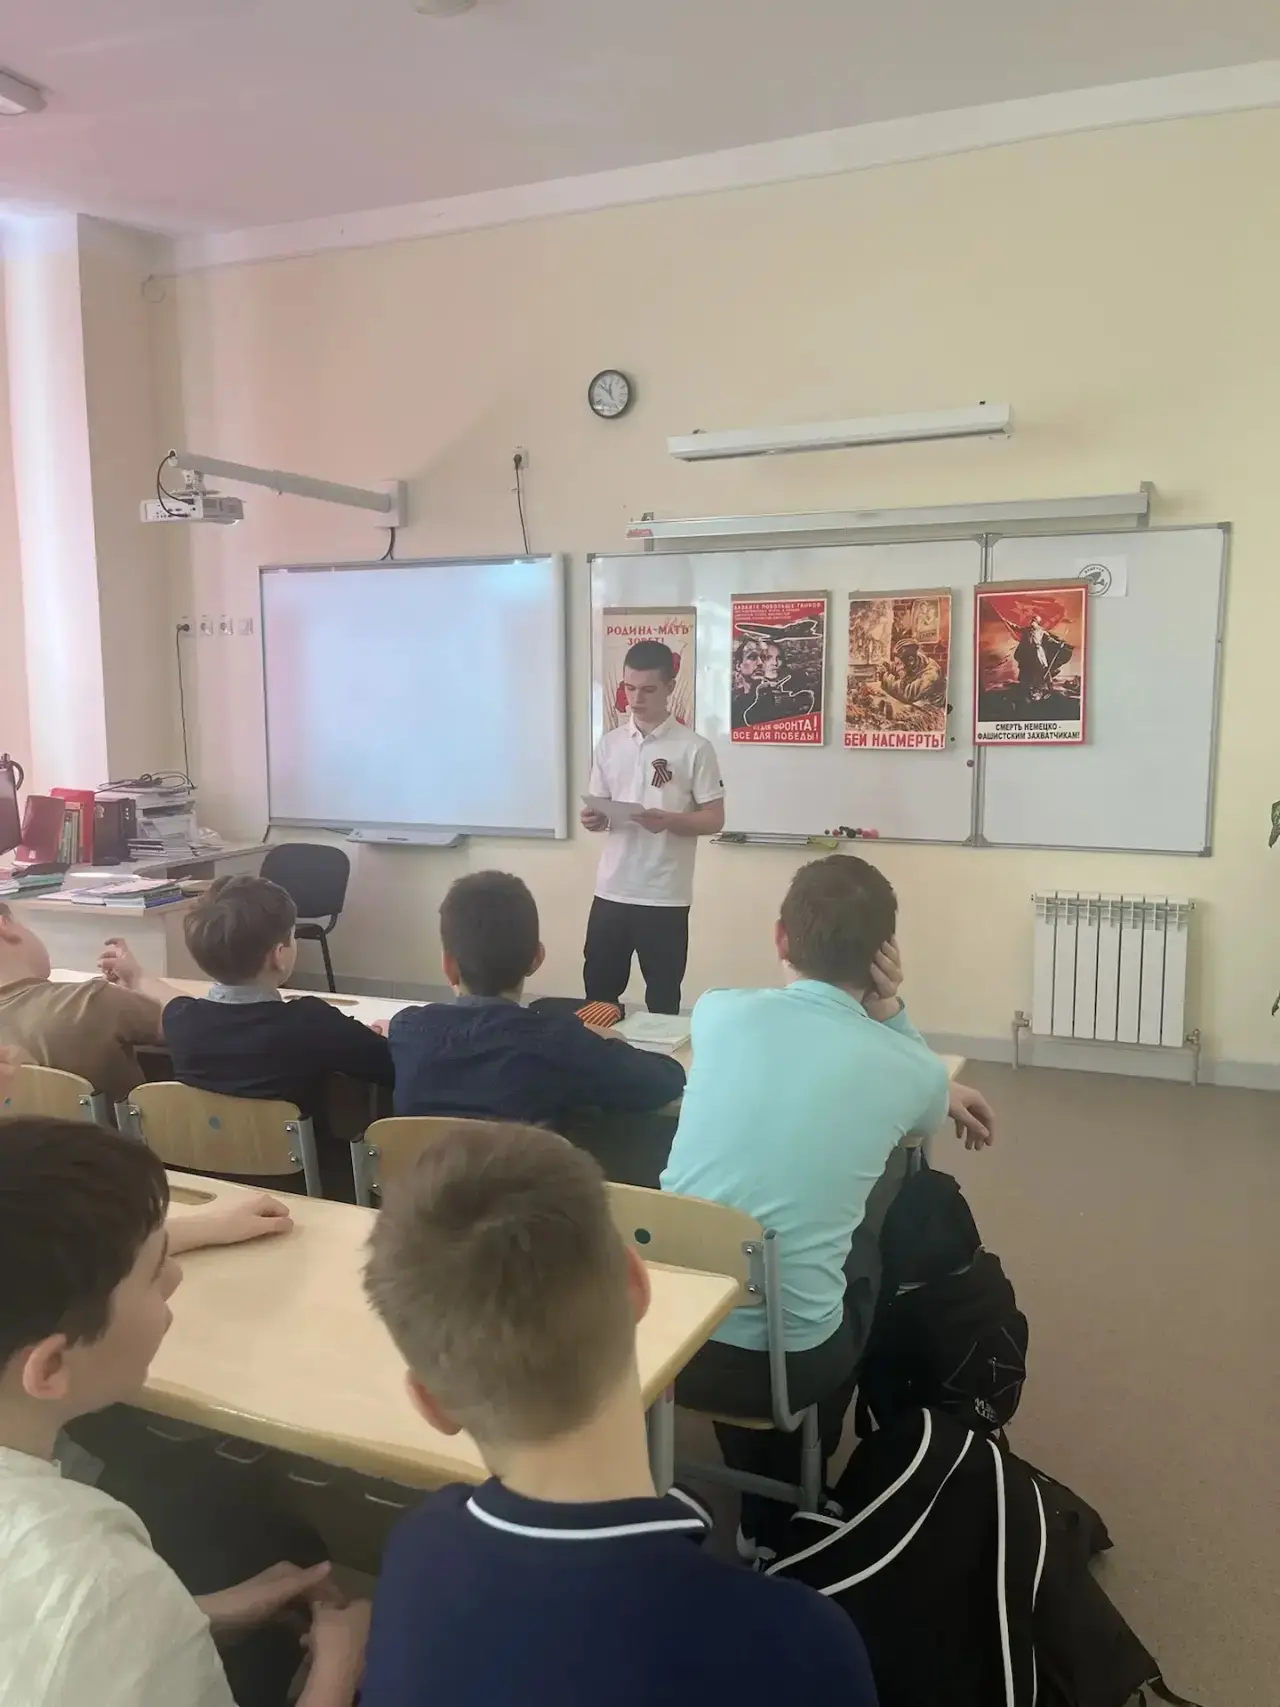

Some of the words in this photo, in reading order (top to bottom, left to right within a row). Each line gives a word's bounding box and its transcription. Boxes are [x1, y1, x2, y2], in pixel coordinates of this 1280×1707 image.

[607, 625, 689, 635] РОДИНА-МАТЬ
[772, 715, 818, 731] ФРОНТА!
[995, 723, 1022, 731] СМЕРТЬ
[733, 731, 751, 740] ВСЕ
[753, 731, 771, 740] ДЛЯ
[774, 731, 819, 741] ПОБЕДЫ!
[872, 733, 945, 748] НАСМЕРТЬ!
[977, 732, 1025, 740] ФАШИСТСКИМ
